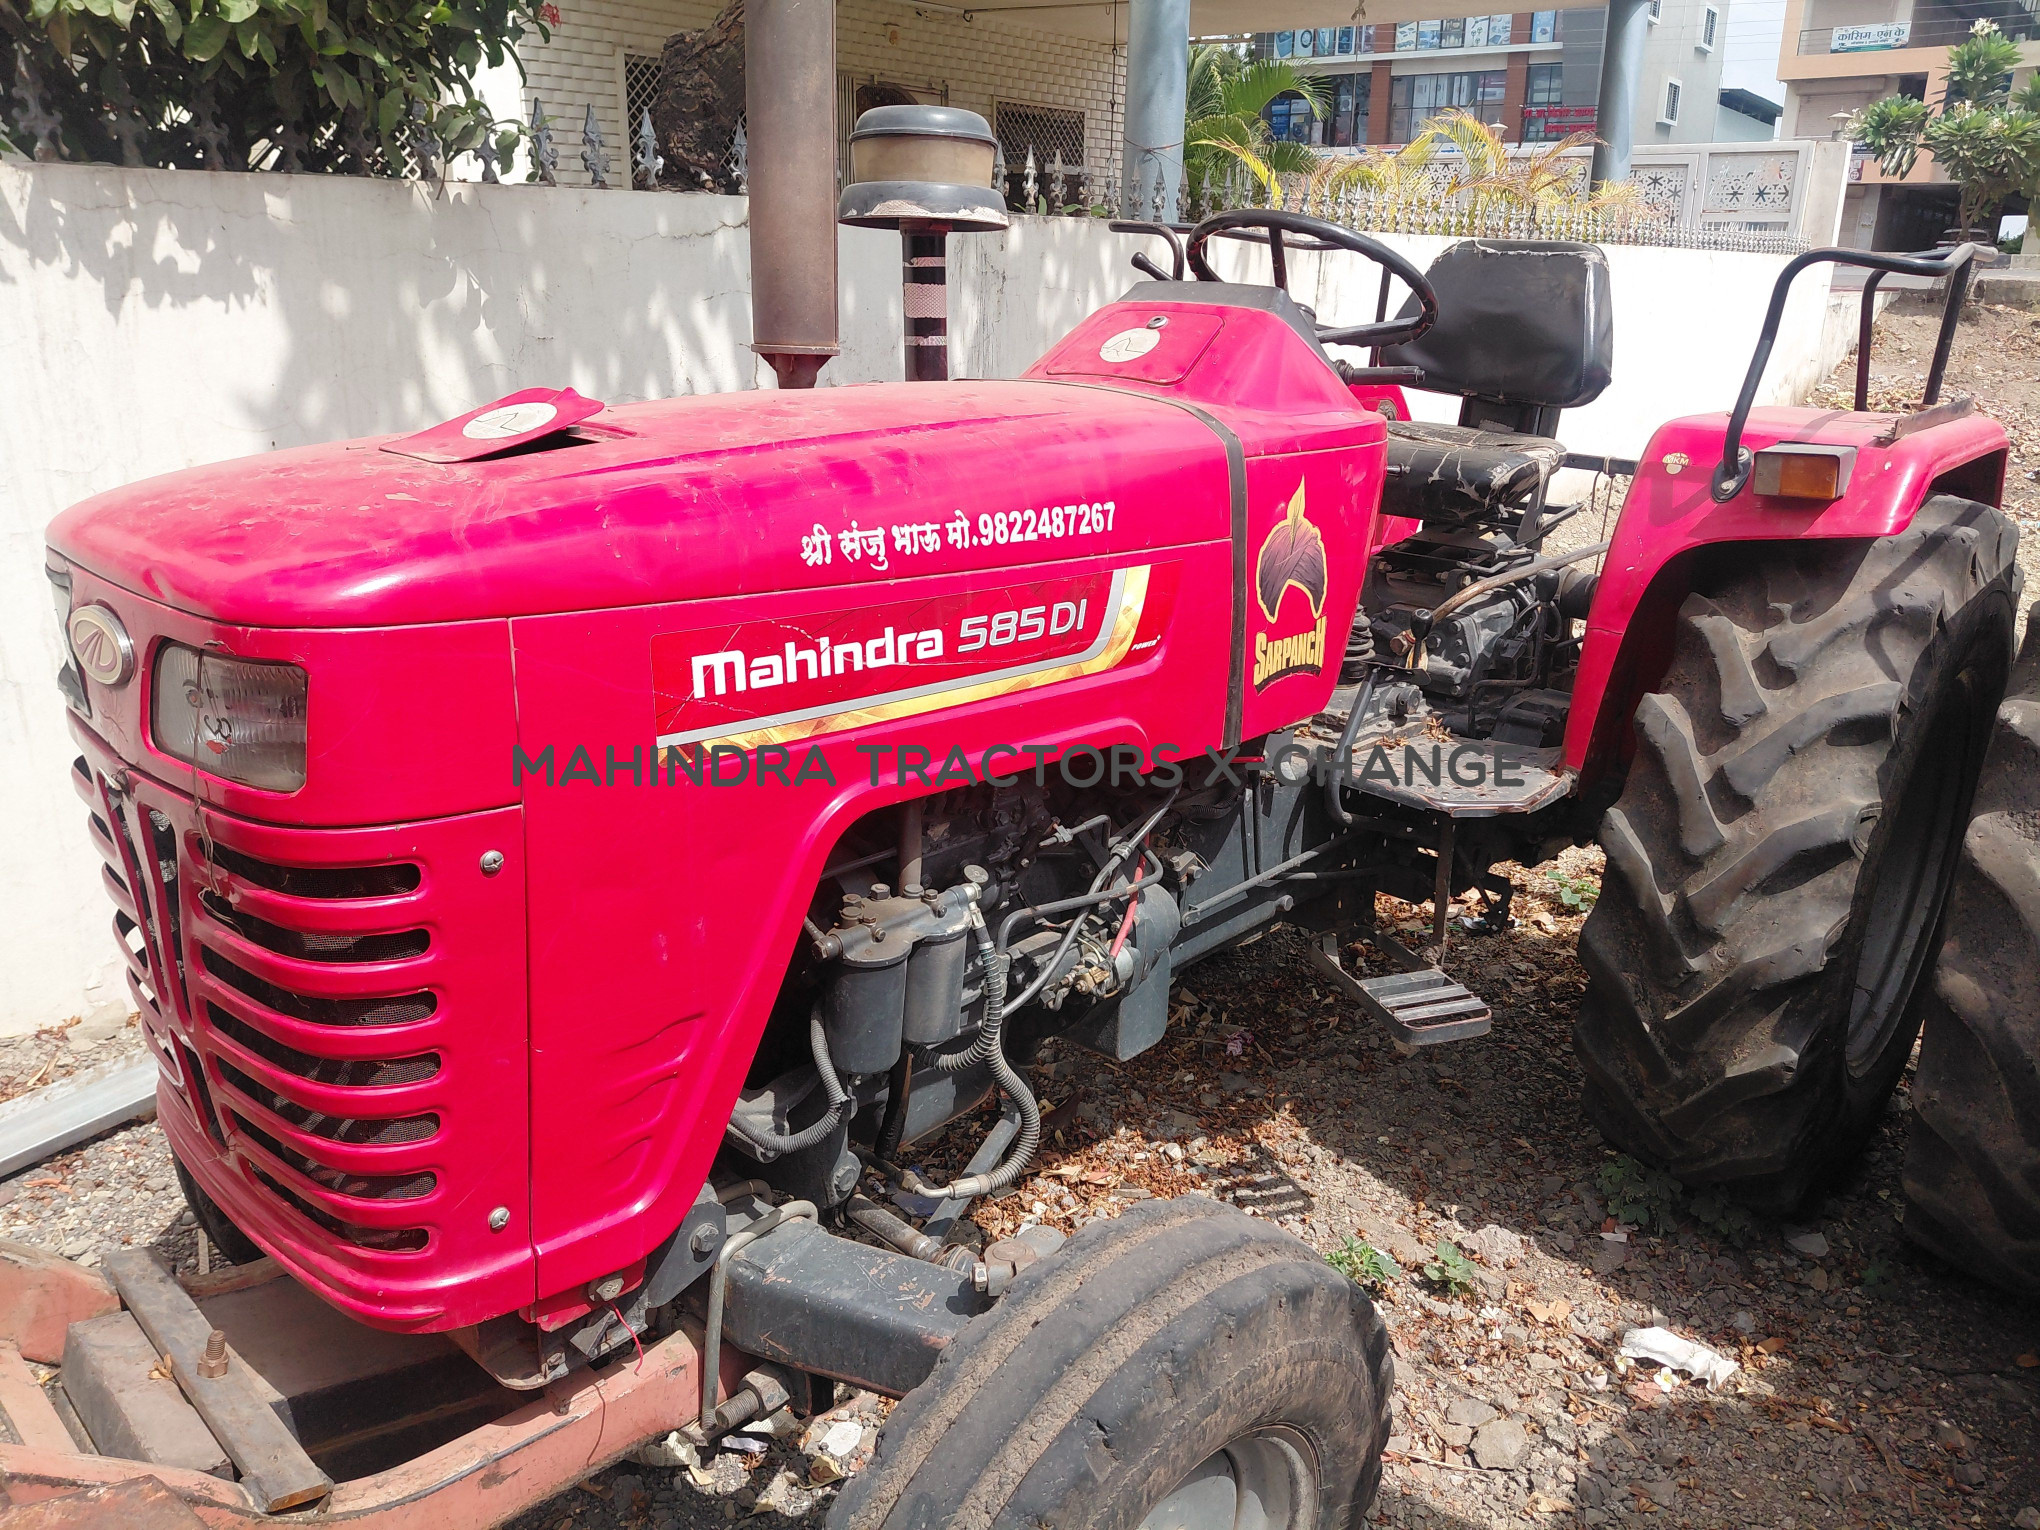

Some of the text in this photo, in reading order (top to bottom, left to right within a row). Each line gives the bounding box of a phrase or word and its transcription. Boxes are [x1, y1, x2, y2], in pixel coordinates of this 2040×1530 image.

[800, 524, 832, 567] श्री
[691, 627, 944, 700] Mahindra
[1253, 615, 1327, 686] SARPANCH
